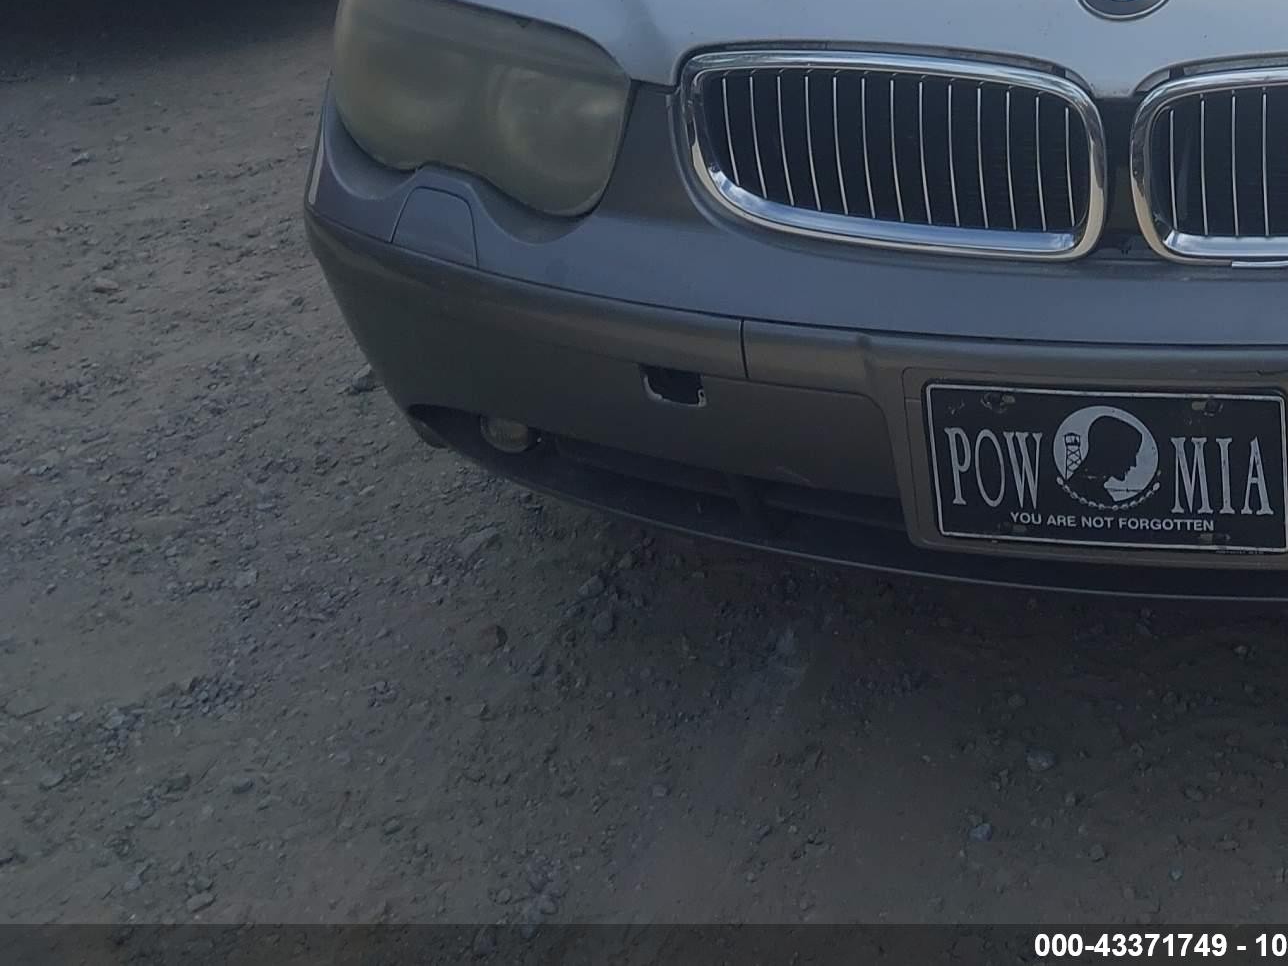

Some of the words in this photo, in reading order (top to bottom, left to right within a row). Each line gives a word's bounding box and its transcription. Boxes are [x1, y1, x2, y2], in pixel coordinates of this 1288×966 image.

[944, 427, 1043, 509] POW
[1170, 436, 1274, 516] MIA
[1011, 512, 1042, 525] YOU
[1046, 514, 1077, 528] ARE
[1081, 516, 1114, 530] NOT
[1118, 517, 1214, 532] FORGOTTEN
